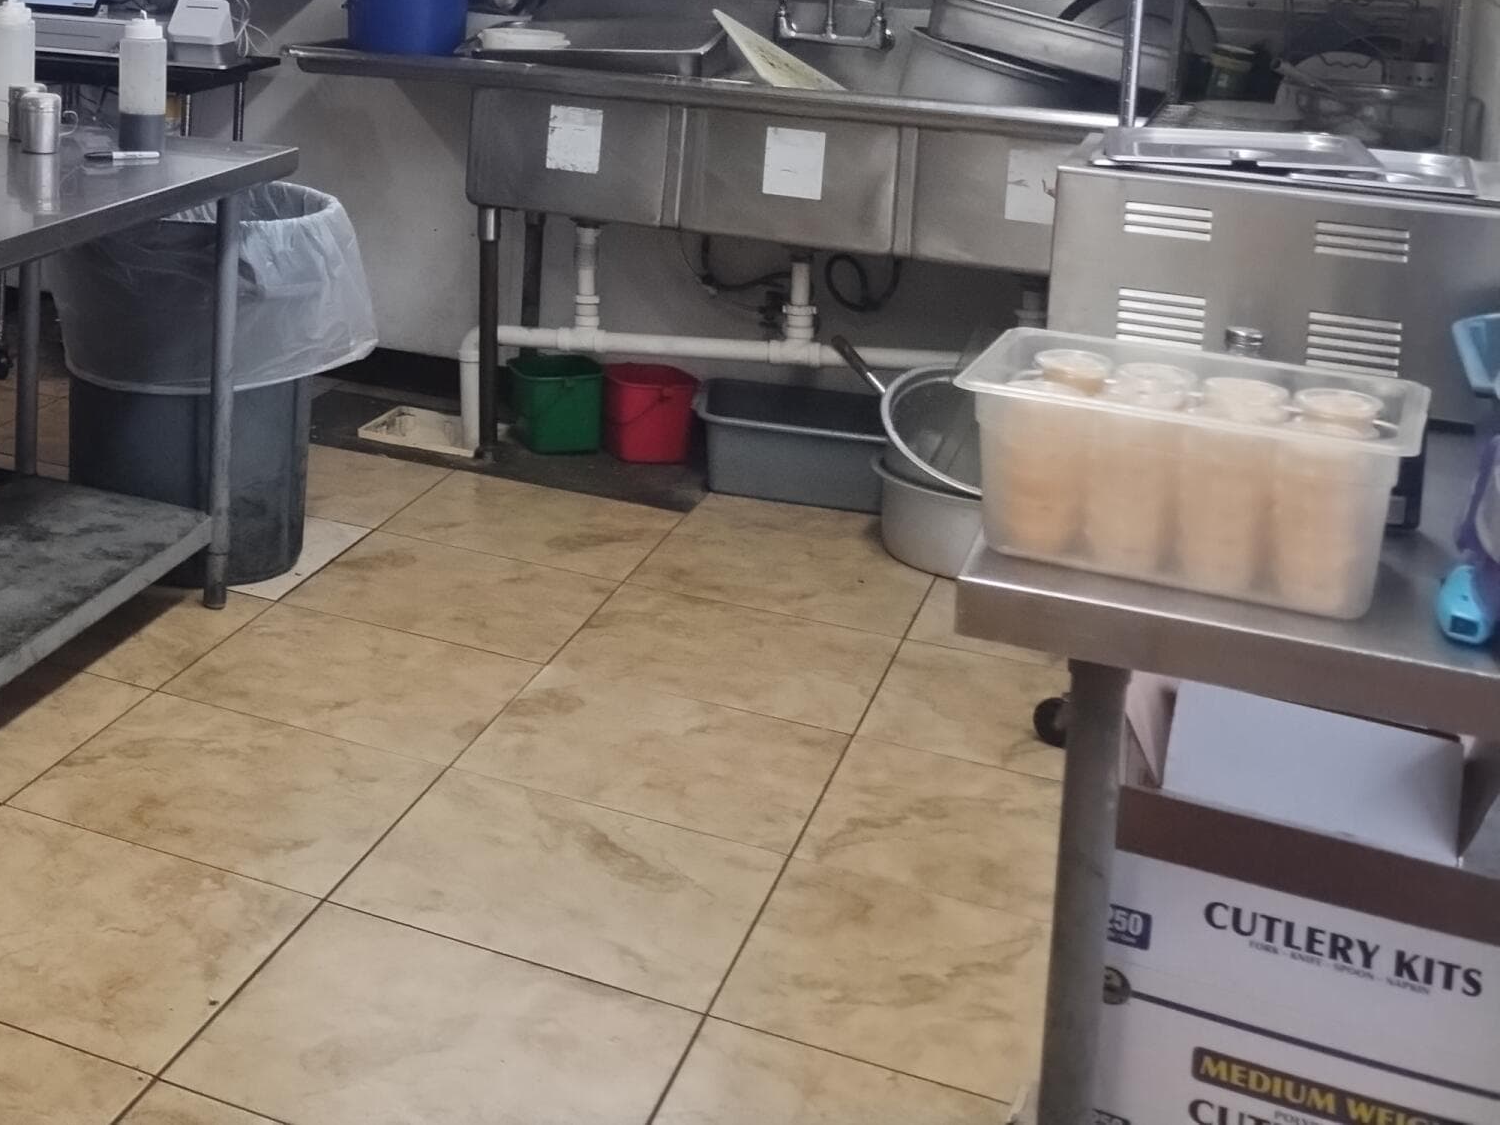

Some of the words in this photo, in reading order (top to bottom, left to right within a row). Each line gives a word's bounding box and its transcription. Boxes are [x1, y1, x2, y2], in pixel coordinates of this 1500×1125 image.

[1203, 901, 1380, 969] CUTLERY
[1394, 949, 1483, 998] KITS
[1201, 1055, 1336, 1115] MEDIUM
